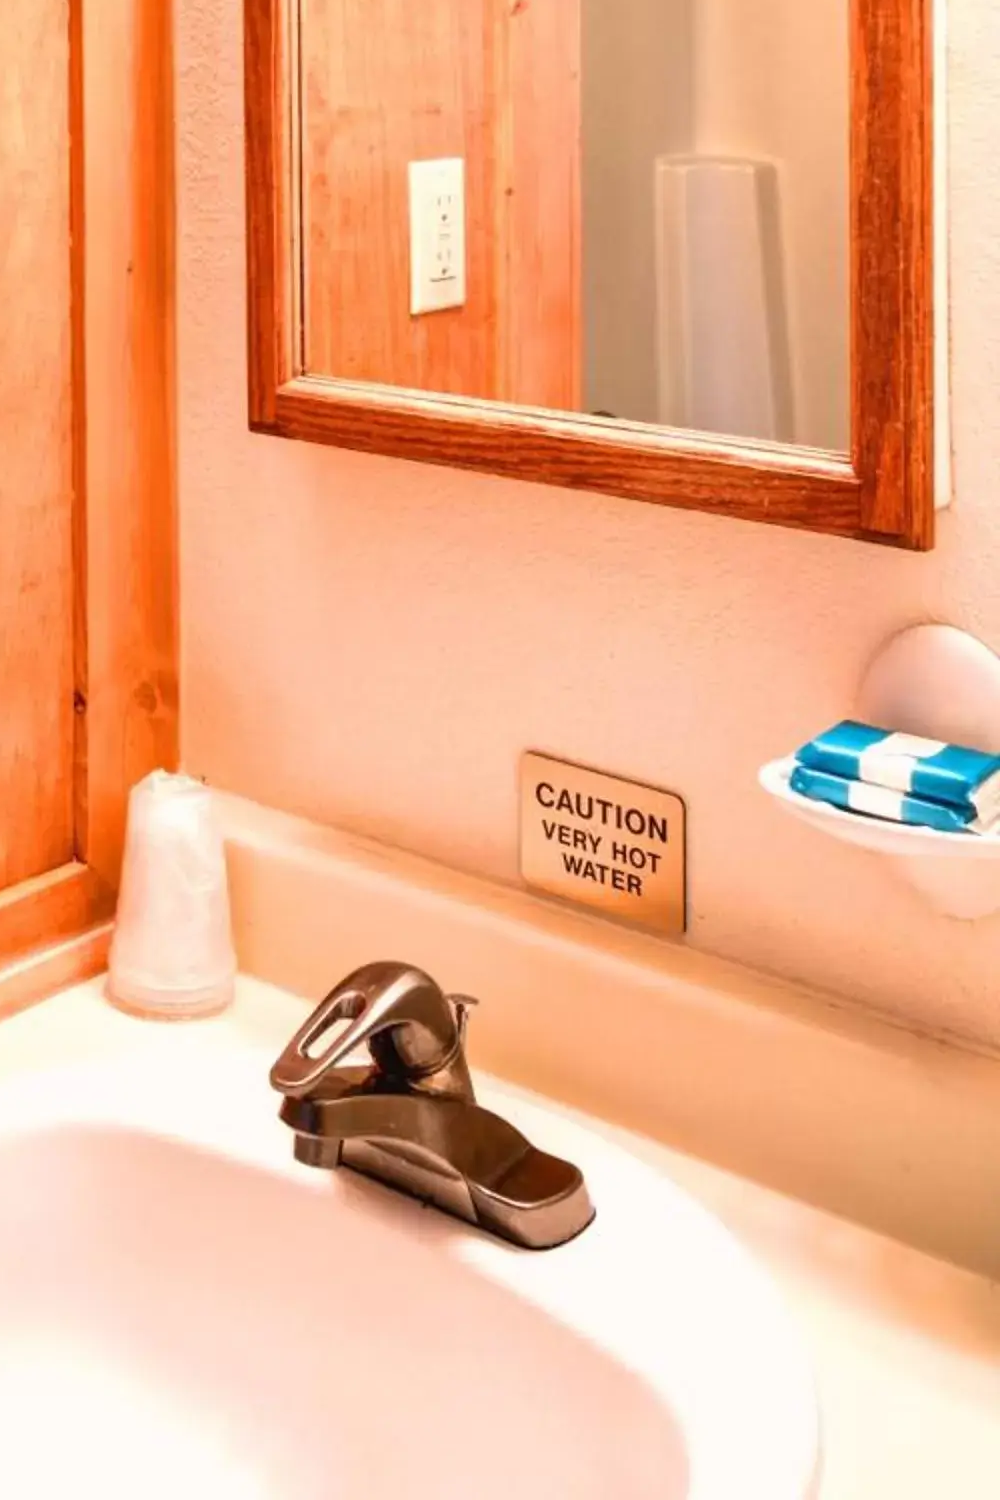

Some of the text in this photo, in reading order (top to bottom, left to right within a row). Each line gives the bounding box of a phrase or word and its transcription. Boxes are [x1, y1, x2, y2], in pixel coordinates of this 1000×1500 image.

[535, 782, 668, 843] CAUTION
[542, 819, 661, 874] VERY HOT
[562, 852, 642, 896] WATER
